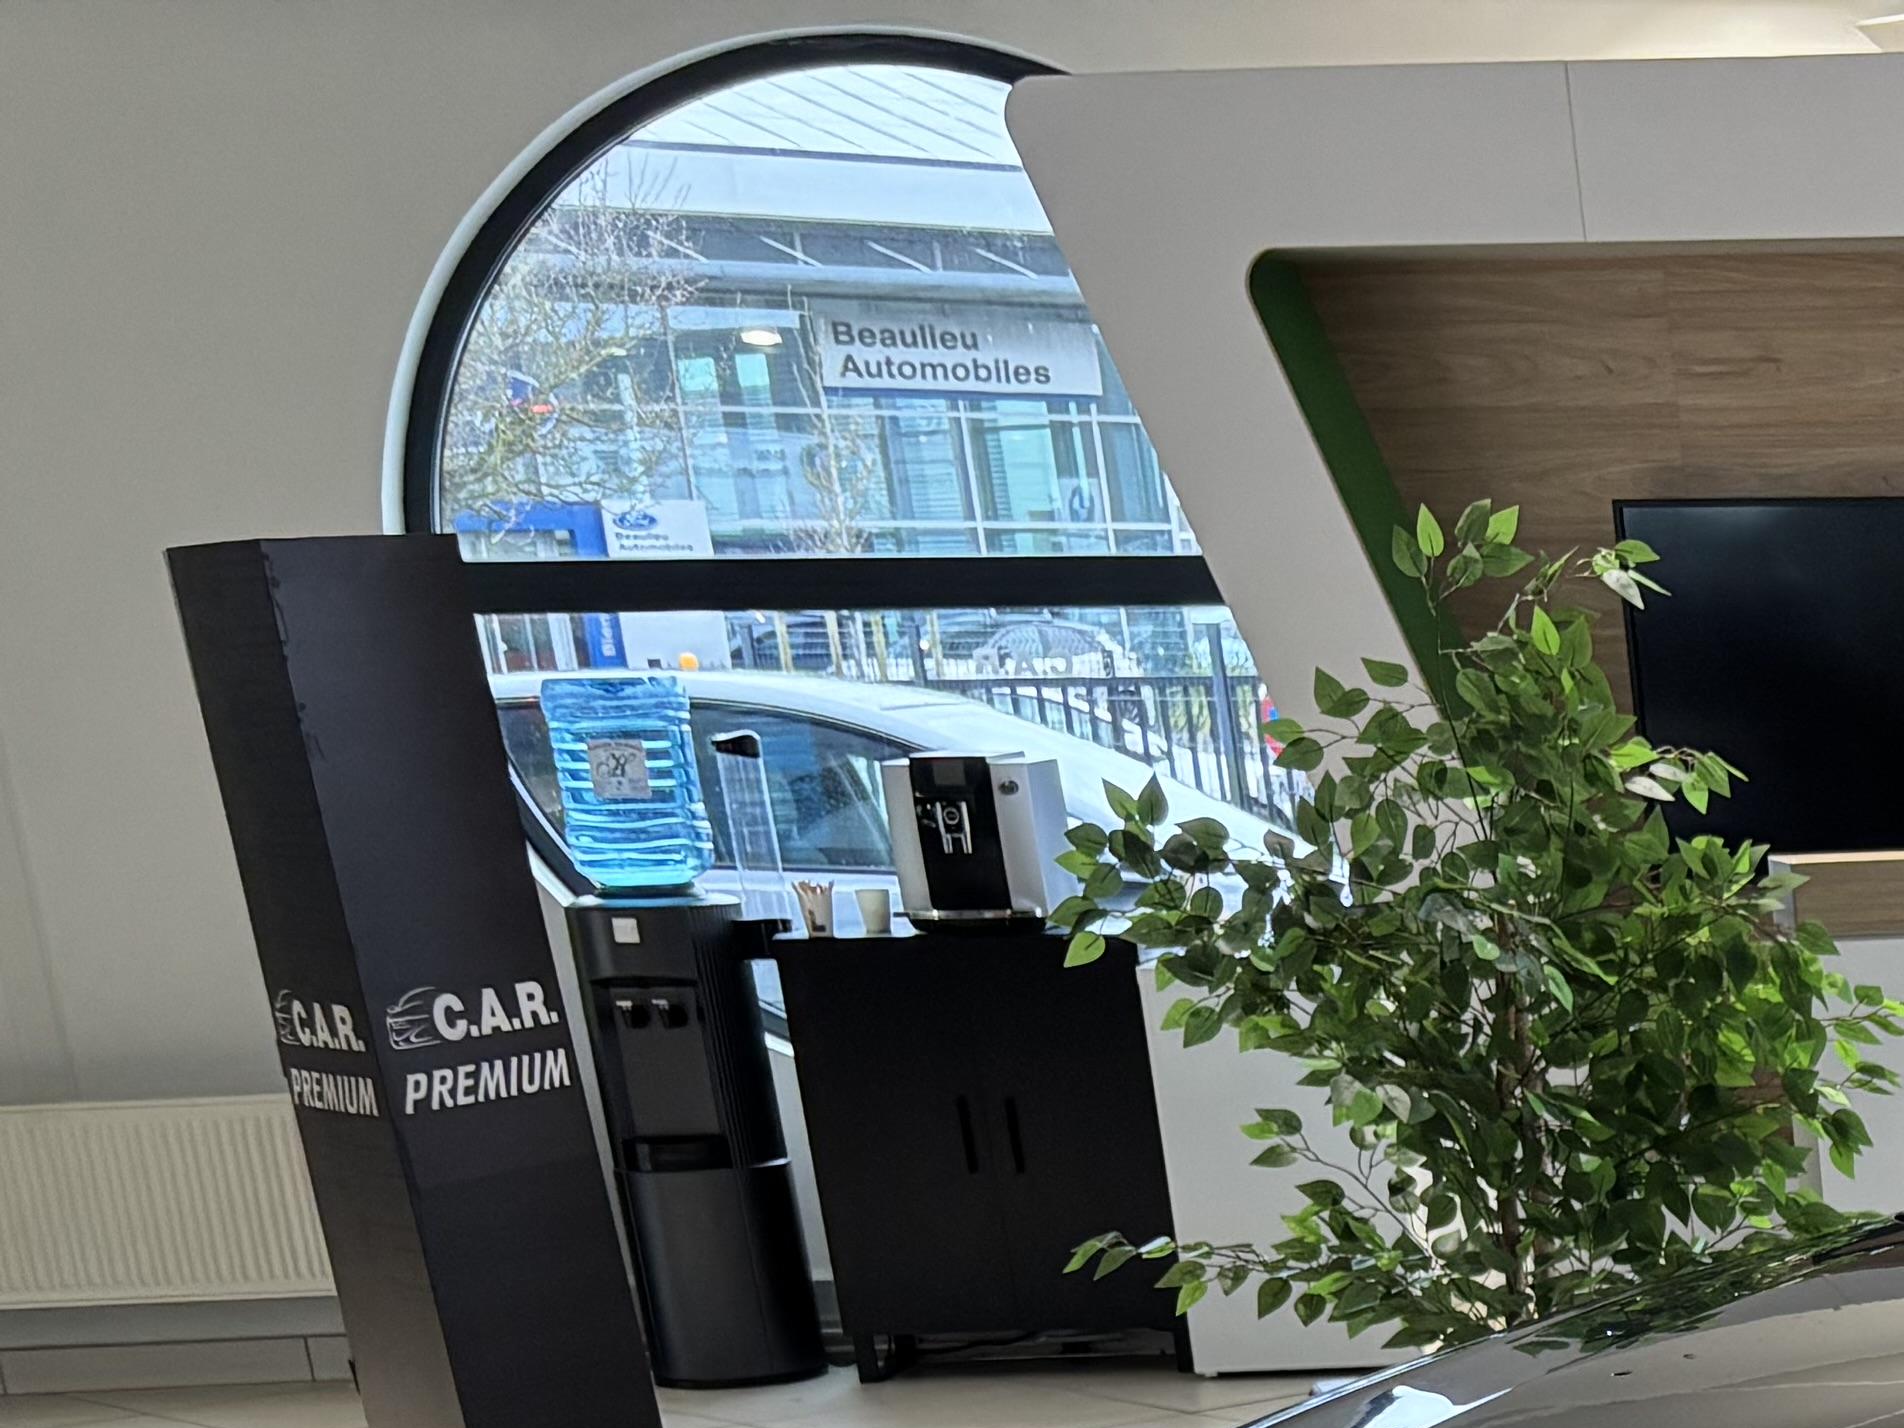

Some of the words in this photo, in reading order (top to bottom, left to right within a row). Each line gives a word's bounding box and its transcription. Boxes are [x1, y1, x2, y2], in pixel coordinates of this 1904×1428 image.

[831, 320, 979, 351] Beaulieu
[840, 354, 1052, 385] Automobiles
[292, 999, 366, 1052] C.A.R.
[433, 981, 559, 1041] C.A.R.
[290, 1067, 379, 1117] PREMIUM
[405, 1048, 571, 1115] PREMIUM
